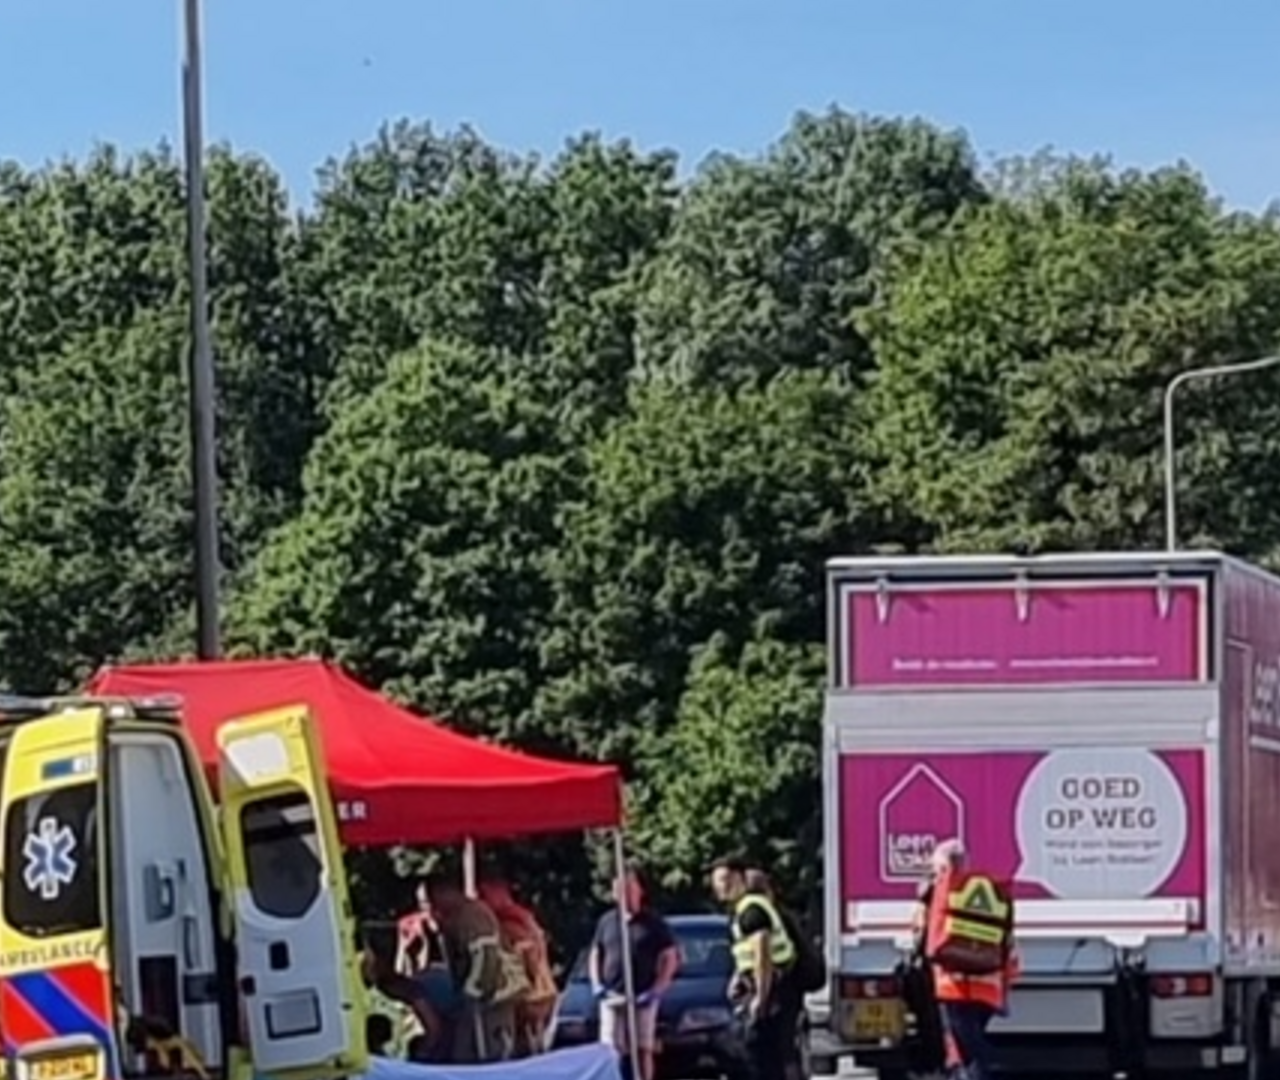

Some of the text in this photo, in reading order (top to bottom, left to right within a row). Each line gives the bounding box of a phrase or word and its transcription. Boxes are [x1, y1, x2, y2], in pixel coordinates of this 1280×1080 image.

[1061, 777, 1141, 800] GOED
[1046, 806, 1157, 830] OP WEG
